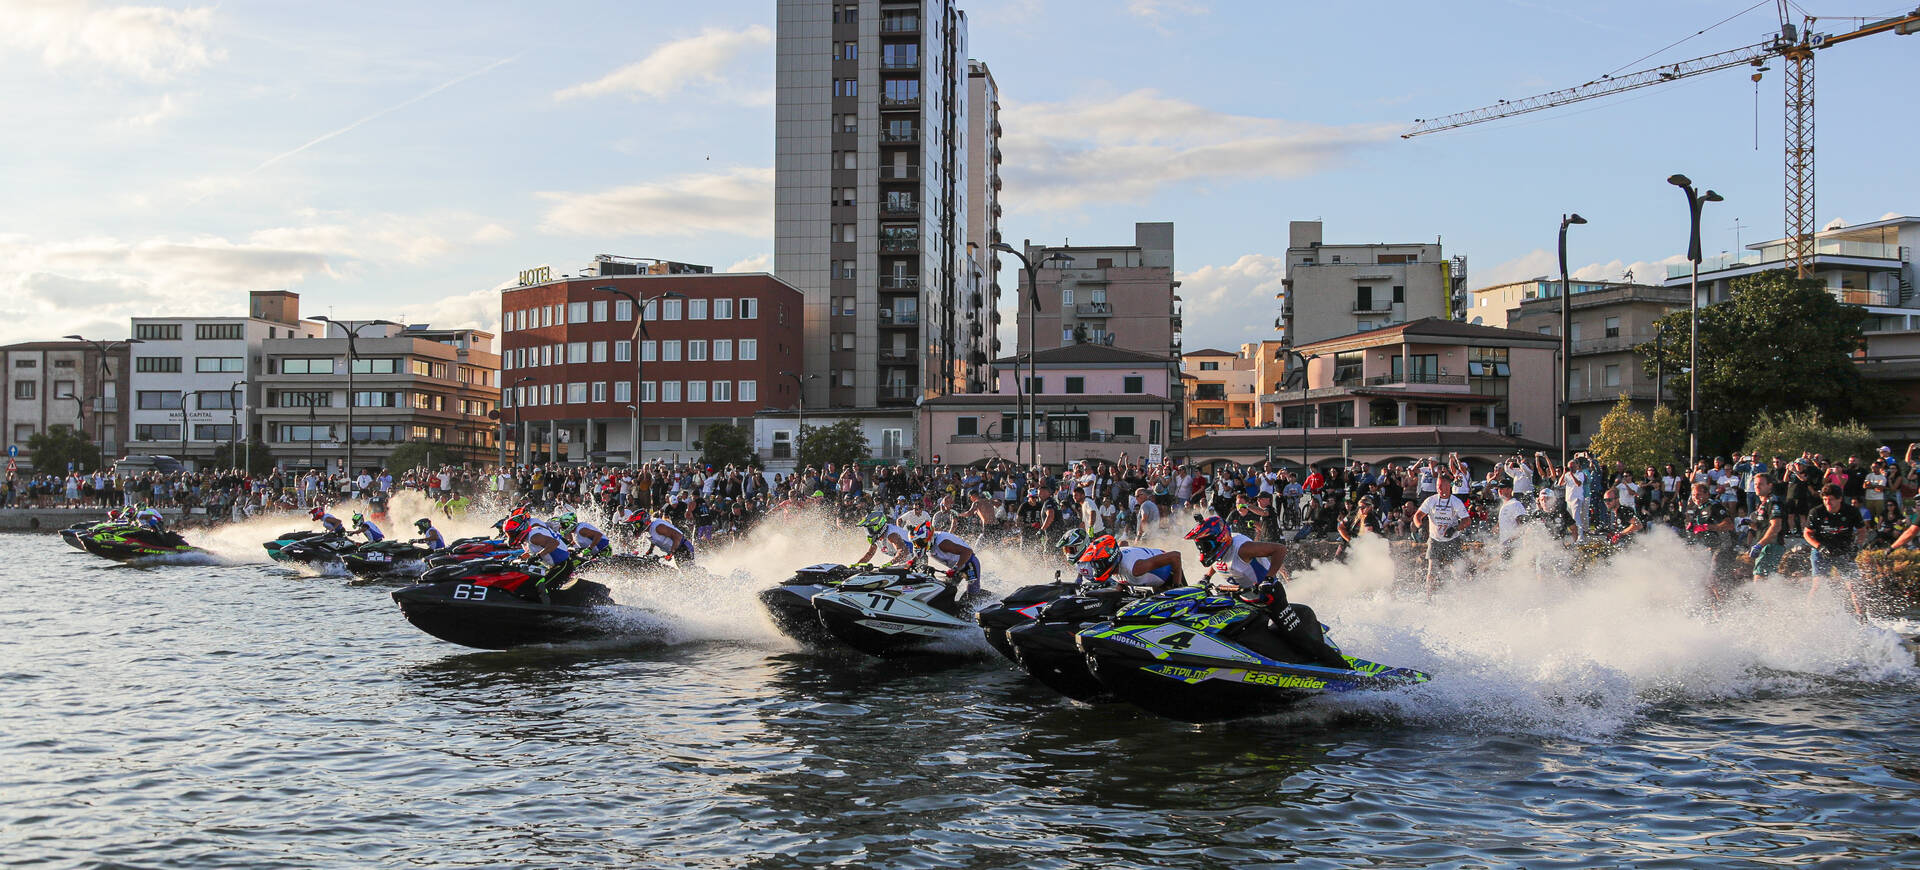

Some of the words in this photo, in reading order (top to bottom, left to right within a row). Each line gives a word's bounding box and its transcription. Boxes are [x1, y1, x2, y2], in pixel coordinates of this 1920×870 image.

[519, 266, 552, 286] HOTEL
[453, 584, 488, 600] 63
[867, 593, 895, 611] 77
[1157, 631, 1196, 650] 4
